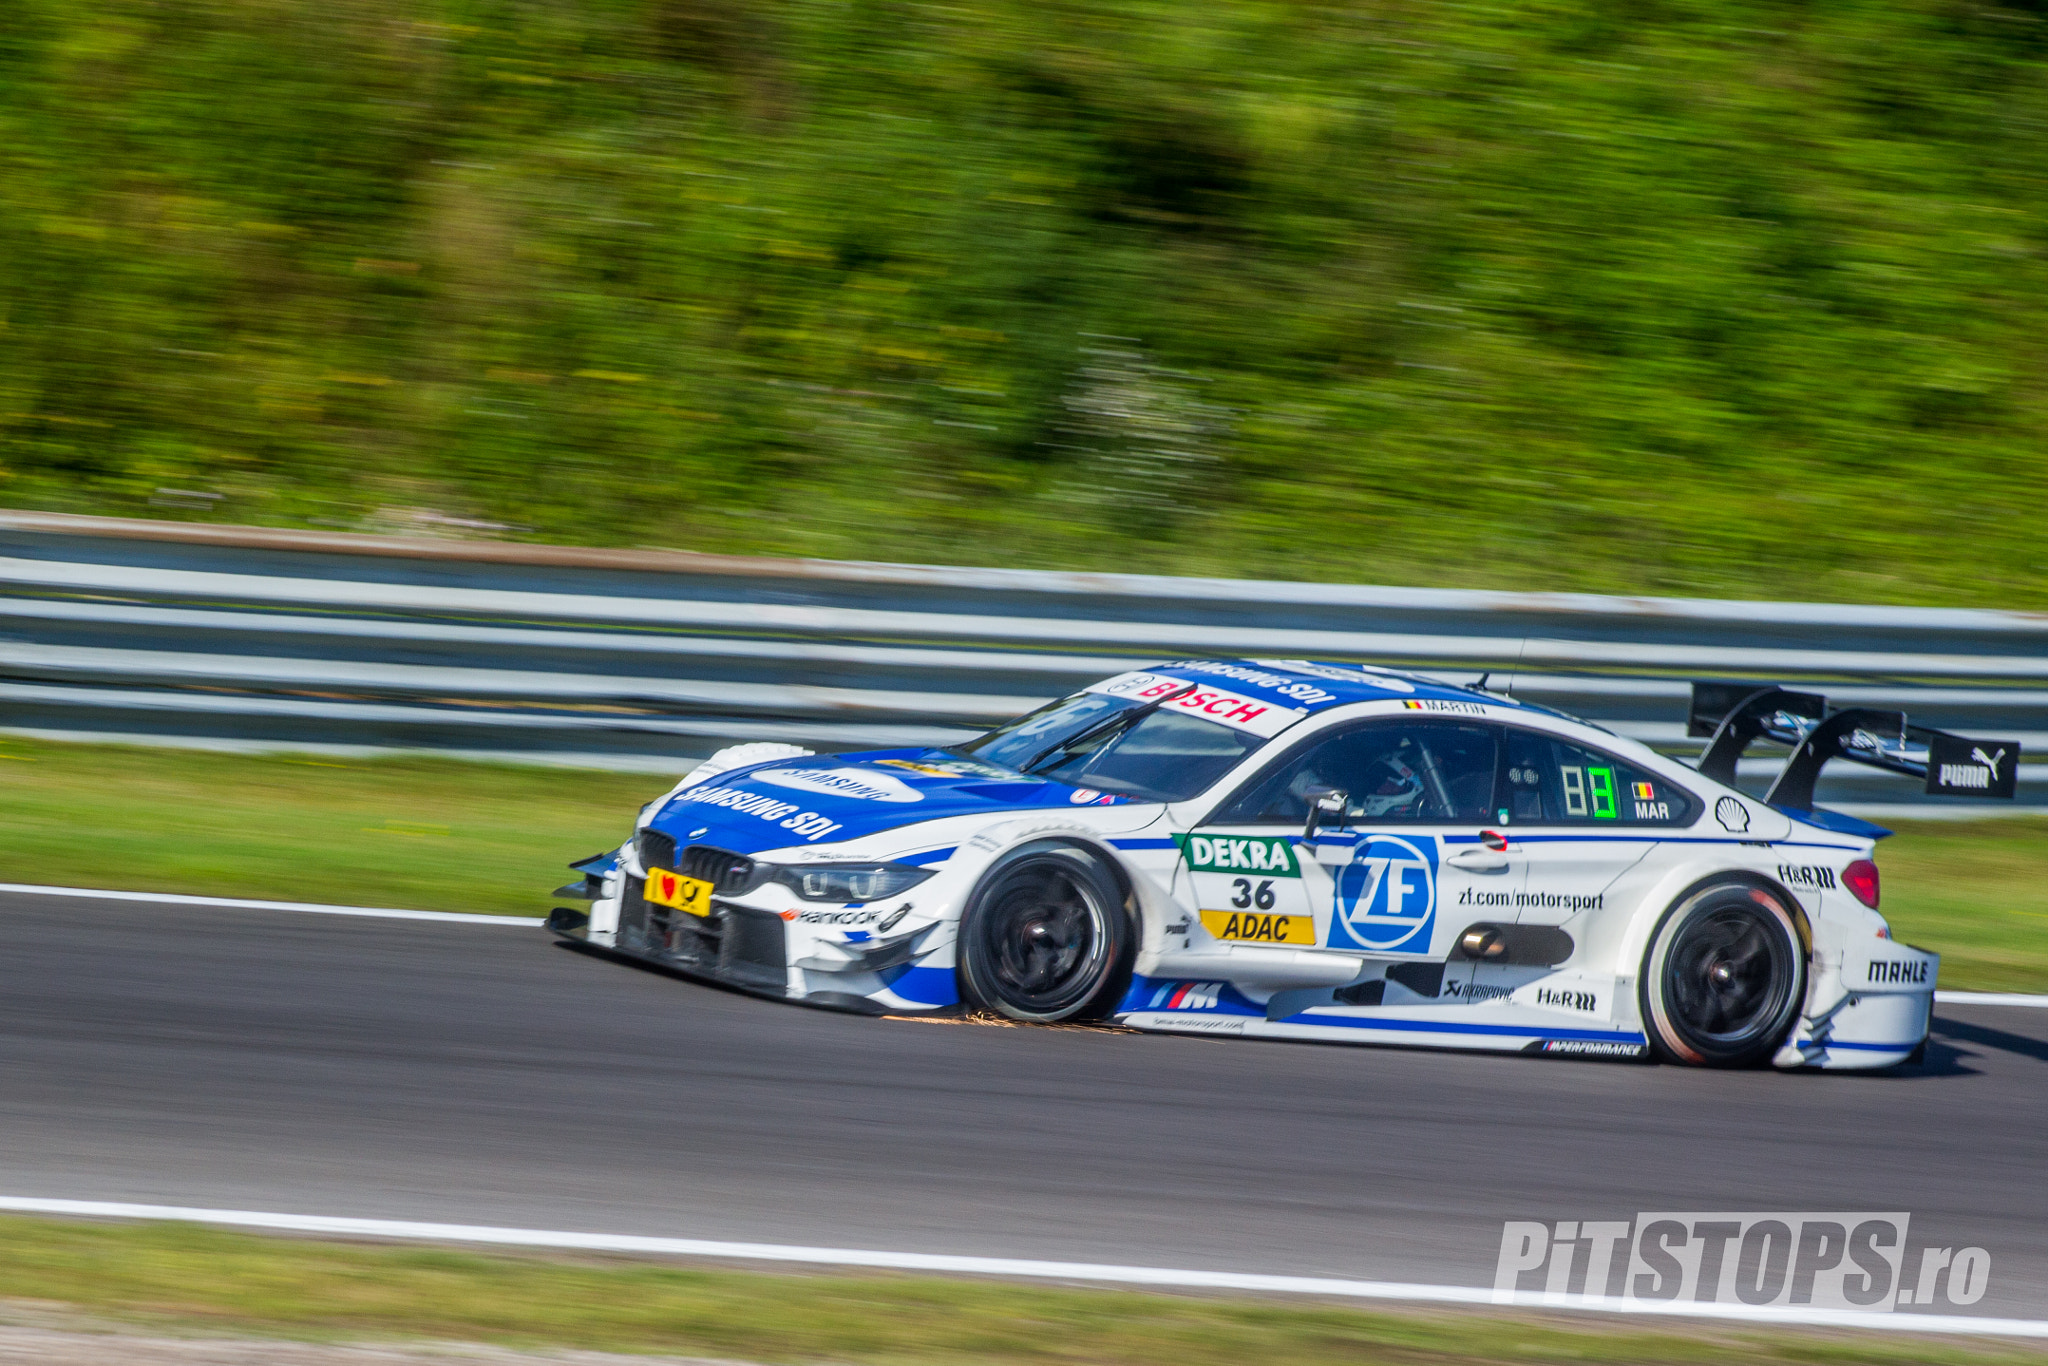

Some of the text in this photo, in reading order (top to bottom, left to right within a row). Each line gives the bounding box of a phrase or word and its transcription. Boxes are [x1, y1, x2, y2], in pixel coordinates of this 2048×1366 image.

[1277, 684, 1336, 705] SDI
[1425, 701, 1486, 715] MARTIN
[783, 769, 892, 801] SAMSUNG
[1939, 764, 1990, 789] PUMA
[676, 786, 843, 841] SAMSUNG SDI
[1635, 802, 1669, 820] MAR
[1191, 837, 1290, 872] DEKRA
[1777, 865, 1814, 885] H&R
[1231, 878, 1275, 910] 36
[1348, 857, 1431, 926] ZF
[1459, 887, 1604, 912] zf.com/motorsport
[1223, 914, 1290, 941] ADAC
[1868, 961, 1928, 983] MAHLE
[1537, 988, 1573, 1008] H&R
